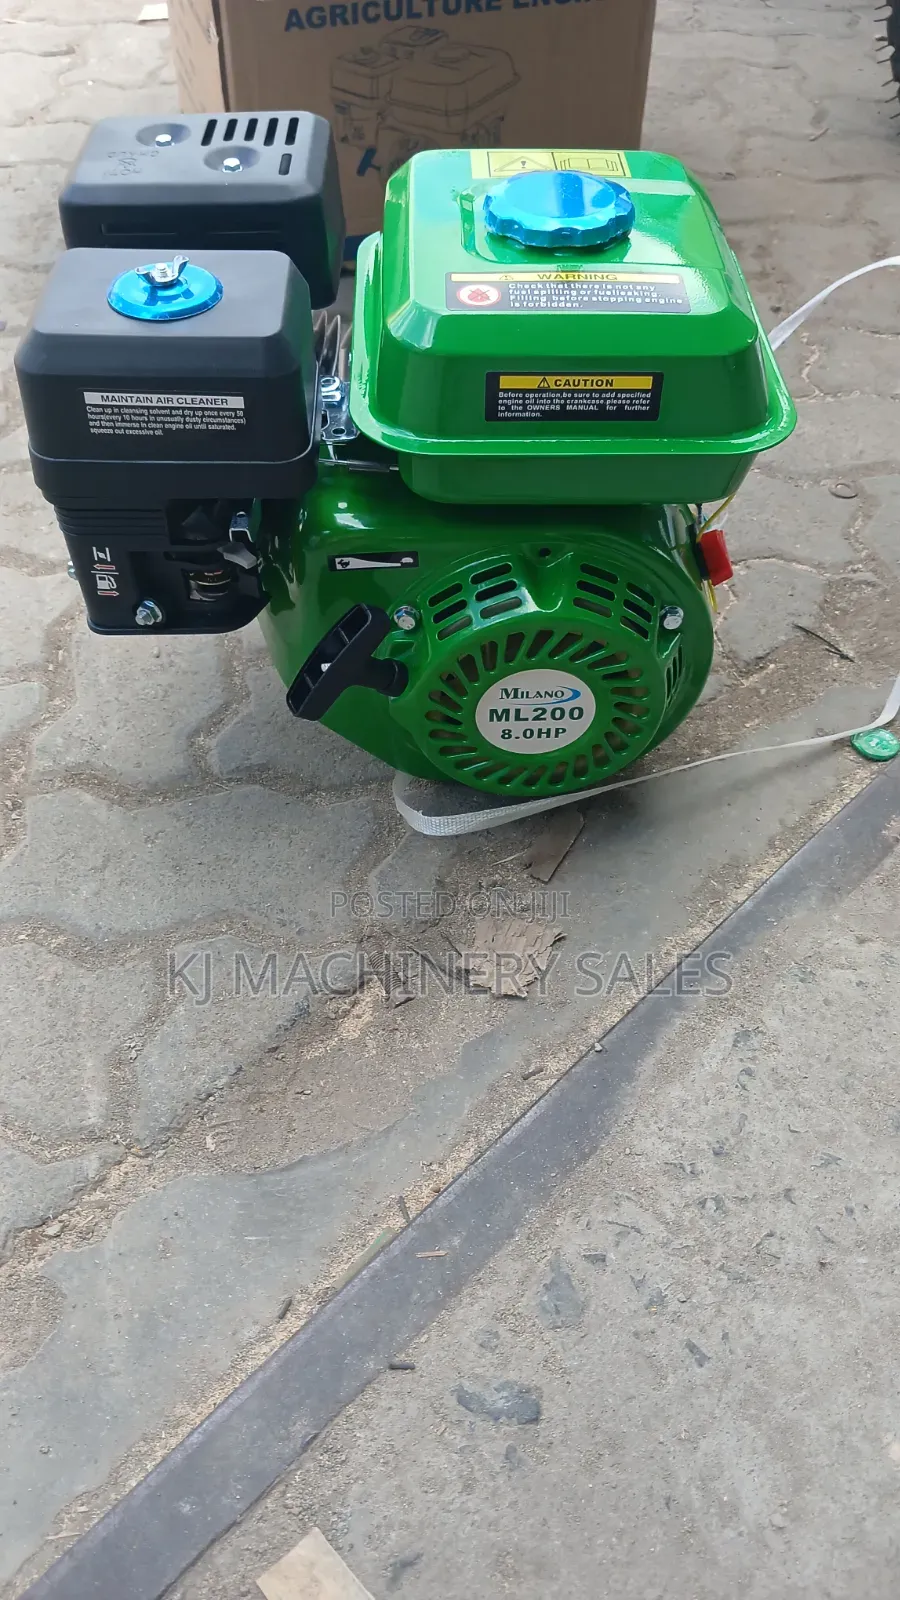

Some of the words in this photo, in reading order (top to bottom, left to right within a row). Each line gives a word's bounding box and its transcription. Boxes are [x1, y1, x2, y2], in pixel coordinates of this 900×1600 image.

[537, 273, 618, 281] WARNING
[554, 379, 614, 388] CAUTION
[100, 395, 153, 404] MAINTAIN
[156, 397, 174, 405] AIR
[176, 397, 228, 406] CLEANER
[120, 407, 148, 416] cleansing
[185, 416, 201, 424] dusty
[499, 687, 565, 699] MILANO
[489, 707, 584, 722] ML200
[500, 727, 567, 740] 8.0HP
